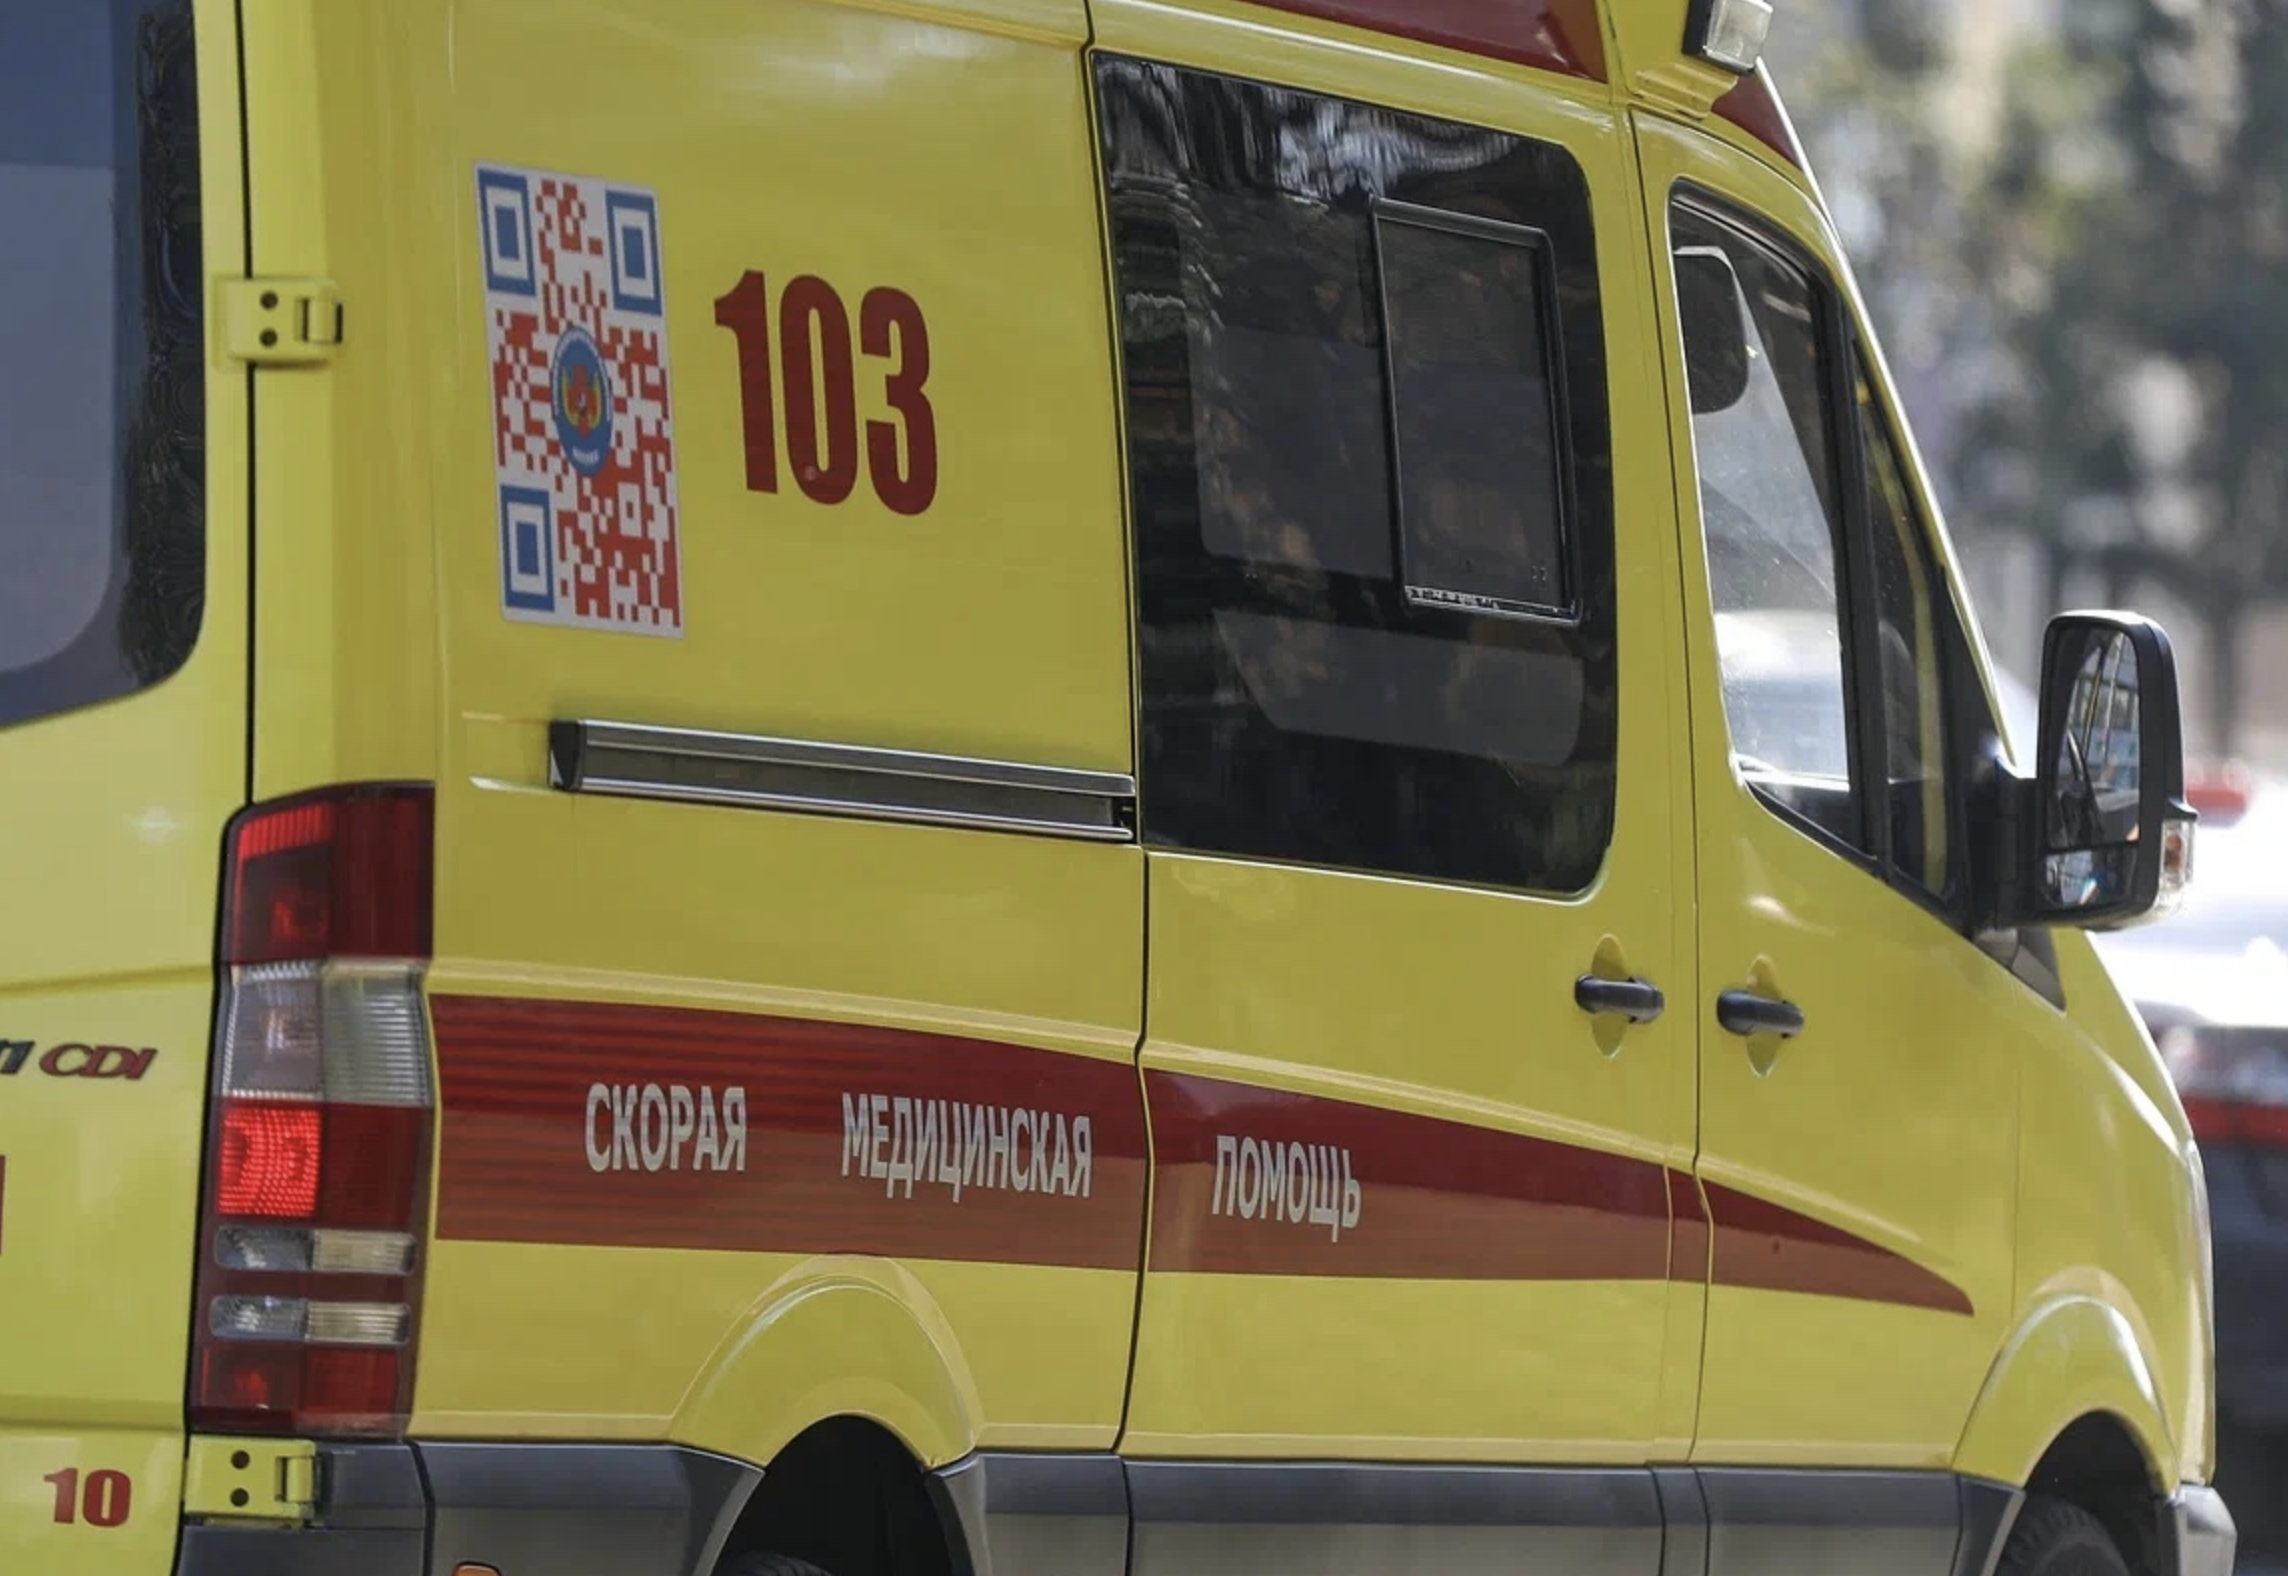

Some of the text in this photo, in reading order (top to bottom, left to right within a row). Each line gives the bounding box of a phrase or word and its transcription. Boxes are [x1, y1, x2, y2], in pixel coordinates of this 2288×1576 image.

[714, 269, 937, 516] 103
[39, 1043, 157, 1080] CDI
[585, 1083, 1362, 1242] СКОРАЯ МЕДИЦИНСКАЯ ПОМОЩЬ
[43, 1467, 131, 1527] 10
